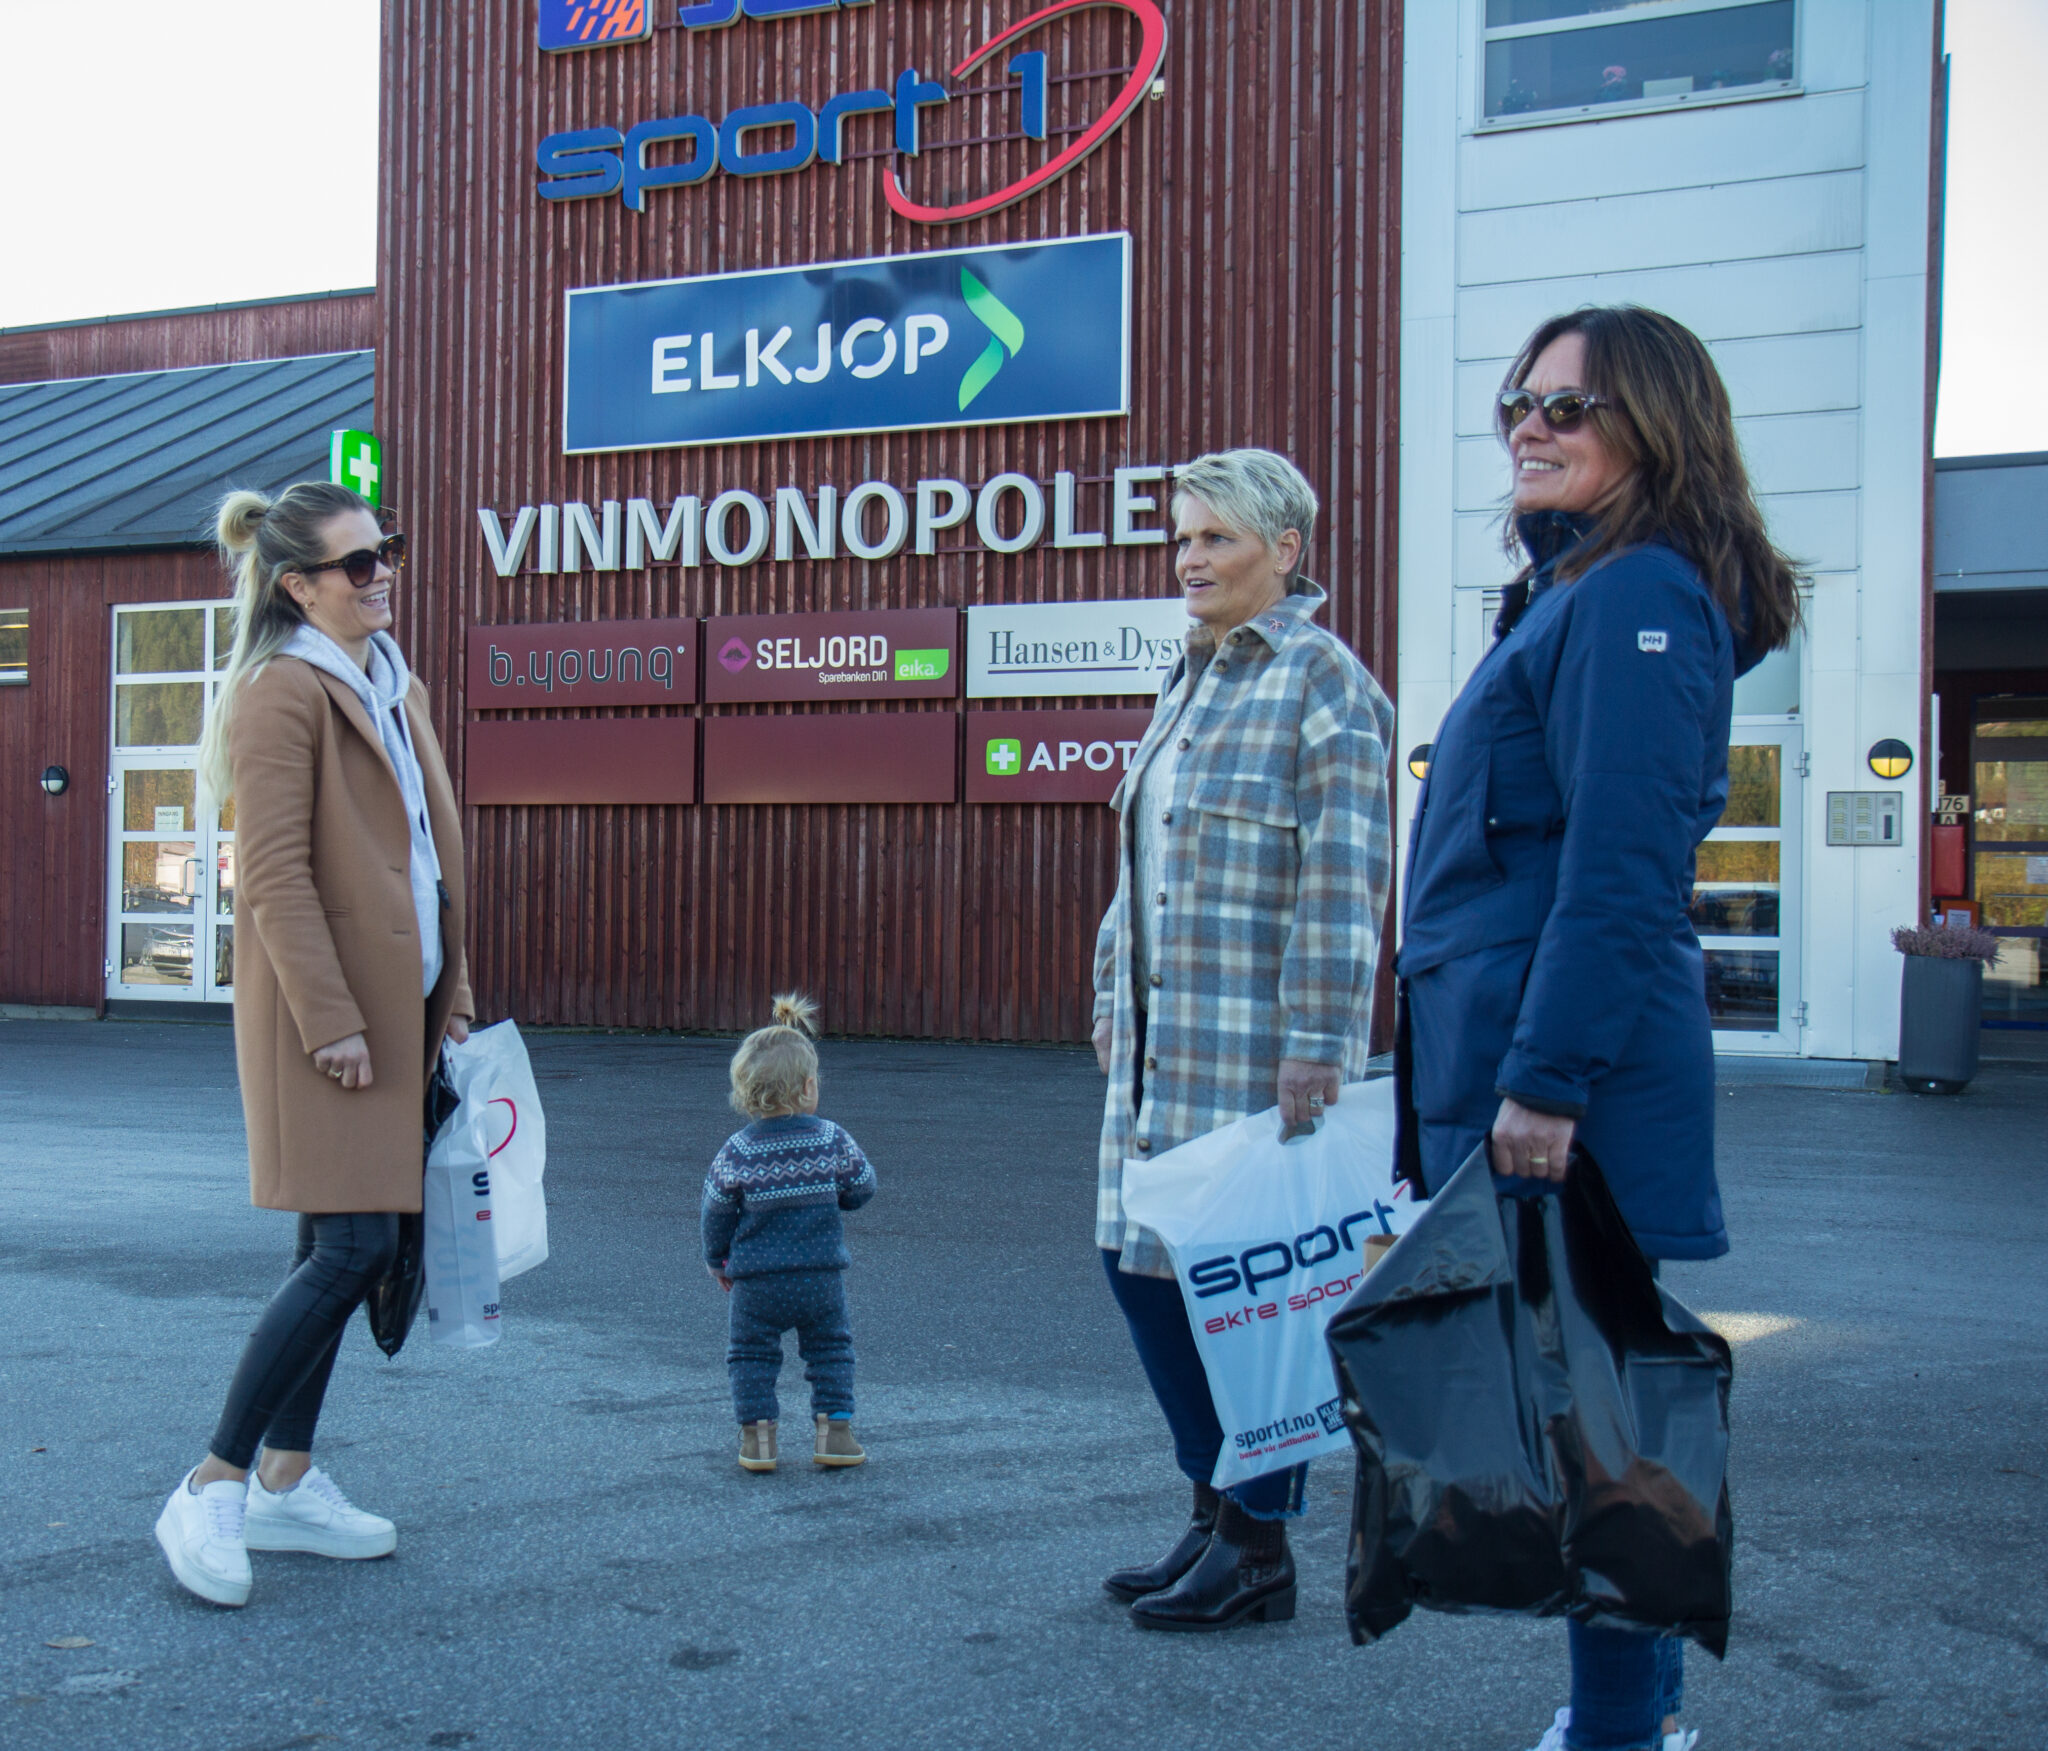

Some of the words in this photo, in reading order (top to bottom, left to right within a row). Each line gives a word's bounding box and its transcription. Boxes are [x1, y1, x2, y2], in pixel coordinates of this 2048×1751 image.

[537, 68, 949, 213] sport
[1008, 50, 1048, 141] 1
[477, 465, 1190, 577] VINMONOPOLE
[756, 635, 888, 670] SELJORD
[987, 630, 1099, 665] Hansen
[1103, 641, 1116, 656] &
[818, 671, 870, 684] Sparebanken
[872, 671, 887, 682] DIN
[1188, 1197, 1395, 1298] sport
[1204, 1300, 1279, 1335] ekte
[1287, 1268, 1364, 1311] spor
[1234, 1412, 1316, 1449] sport1.no
